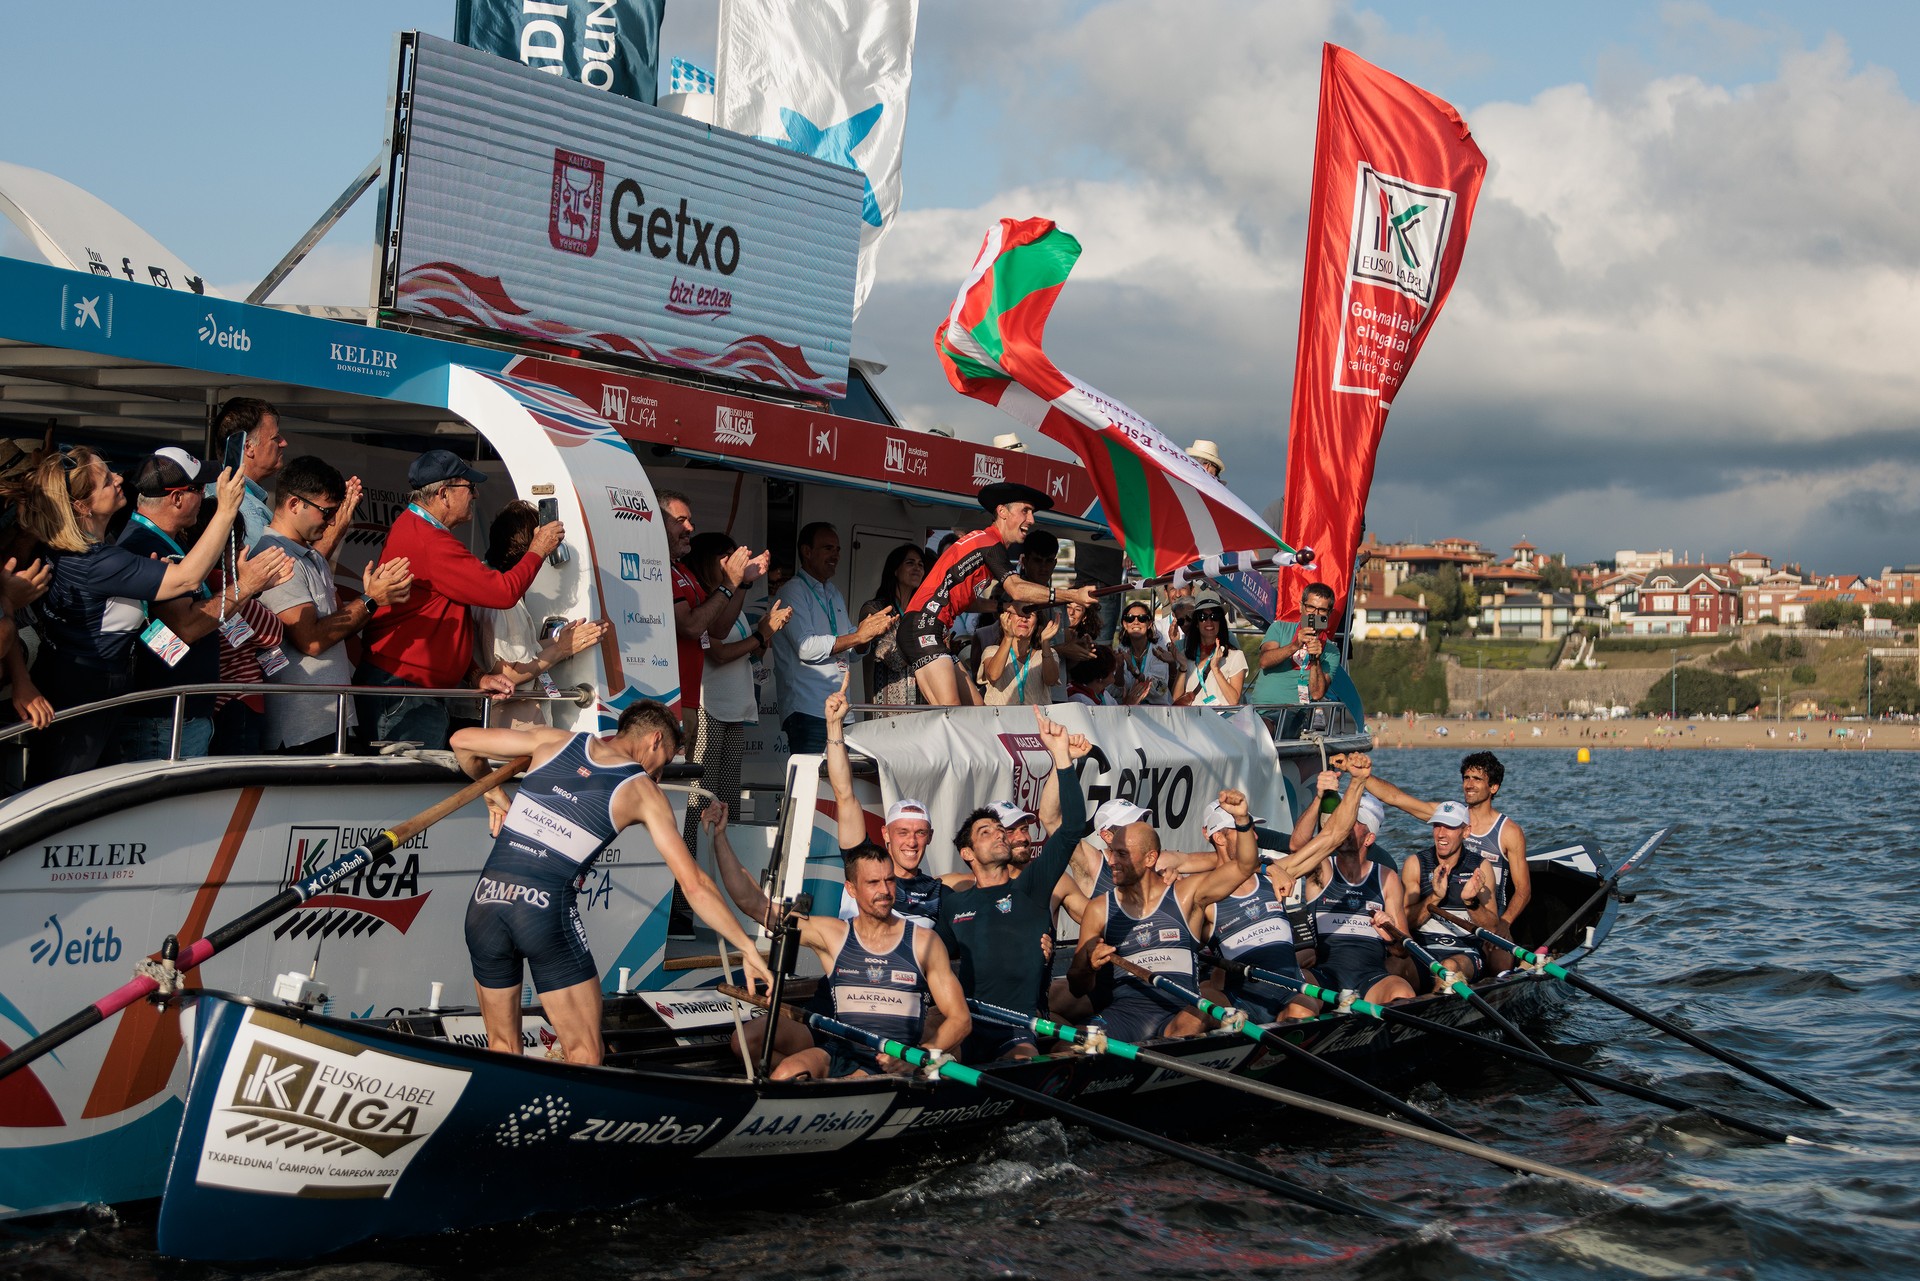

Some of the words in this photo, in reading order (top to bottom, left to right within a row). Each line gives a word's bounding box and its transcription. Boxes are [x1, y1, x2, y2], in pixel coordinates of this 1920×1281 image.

[610, 178, 740, 275] Getxo
[85, 247, 103, 263] You
[1362, 255, 1394, 275] EUSKO
[669, 276, 696, 305] bizi
[697, 287, 732, 308] ezazu
[218, 326, 251, 351] eitb
[330, 342, 398, 369] KELER
[337, 364, 374, 375] DONOSTIA
[375, 369, 391, 378] 1872
[631, 395, 658, 407] euskotren
[630, 407, 657, 428] LIGA
[729, 407, 743, 417] EUSKO
[743, 410, 754, 418] LABEL
[729, 416, 754, 435] LIGA
[907, 458, 927, 476] LIGA
[984, 463, 1003, 479] LIGA
[371, 489, 396, 503] EUSKO
[623, 495, 649, 512] LIGA
[642, 567, 663, 582] LIGA
[1242, 572, 1269, 604] KELER
[634, 613, 662, 625] CaixaBank
[626, 656, 646, 664] KELER
[658, 657, 669, 667] eitb
[1014, 737, 1042, 748] KALTEA
[552, 785, 572, 799] DIEGO
[571, 795, 579, 804] P.
[521, 807, 573, 840] ALAKRANA
[40, 843, 147, 868] KELER
[509, 840, 538, 855] ZUNIBAL
[51, 871, 109, 881] DONOSTIA
[112, 870, 135, 879] 1872
[320, 854, 365, 886] CaixaBank
[475, 877, 551, 908] CAMPOS
[1236, 925, 1281, 945] ALAKRANA
[65, 926, 122, 965] eitb
[846, 993, 903, 1004] ALAKRANA
[319, 1065, 382, 1095] EUSKO
[384, 1082, 436, 1106] LABEL
[304, 1085, 420, 1135] LIGA
[910, 1098, 1016, 1128] zamakoa
[569, 1115, 723, 1145] zunibal
[737, 1115, 799, 1136] AAA
[806, 1108, 875, 1134] Piskin
[207, 1151, 273, 1170] TXAPELDUNA
[377, 1169, 400, 1177] 2023
